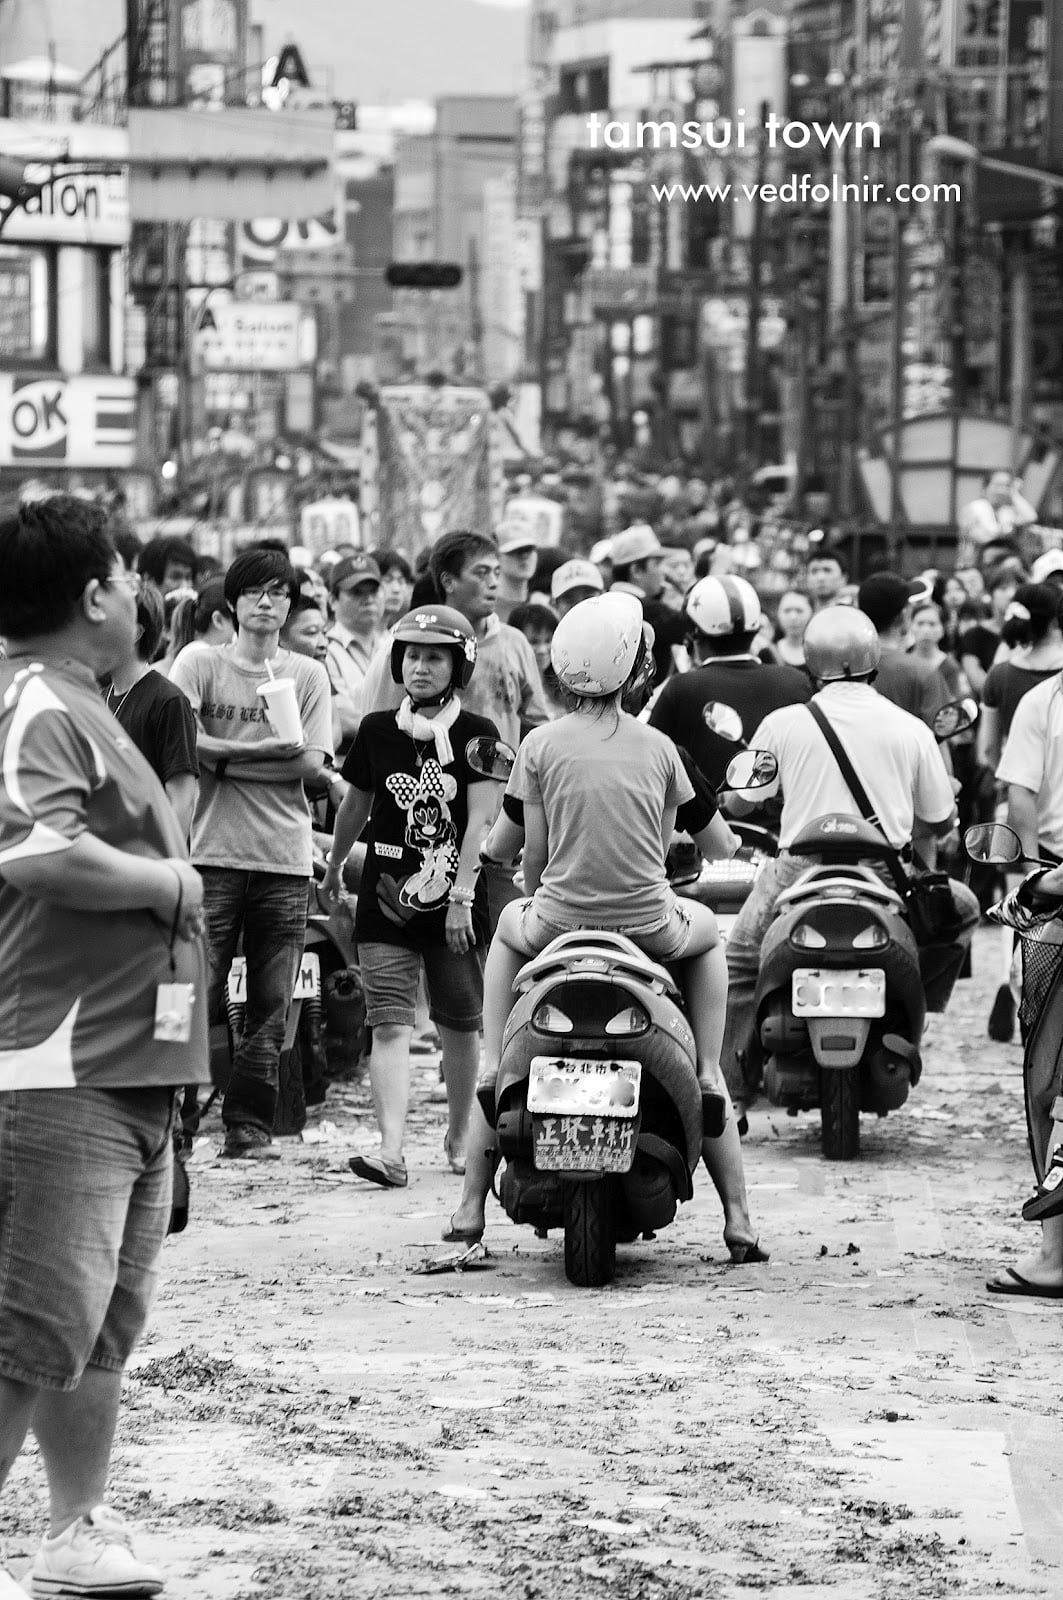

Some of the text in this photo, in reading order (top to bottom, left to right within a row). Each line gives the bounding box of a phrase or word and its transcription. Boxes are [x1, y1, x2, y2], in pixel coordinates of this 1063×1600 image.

[22, 183, 99, 217] alon
[12, 390, 68, 438] OK
[239, 706, 270, 724] LEA
[301, 969, 314, 989] M
